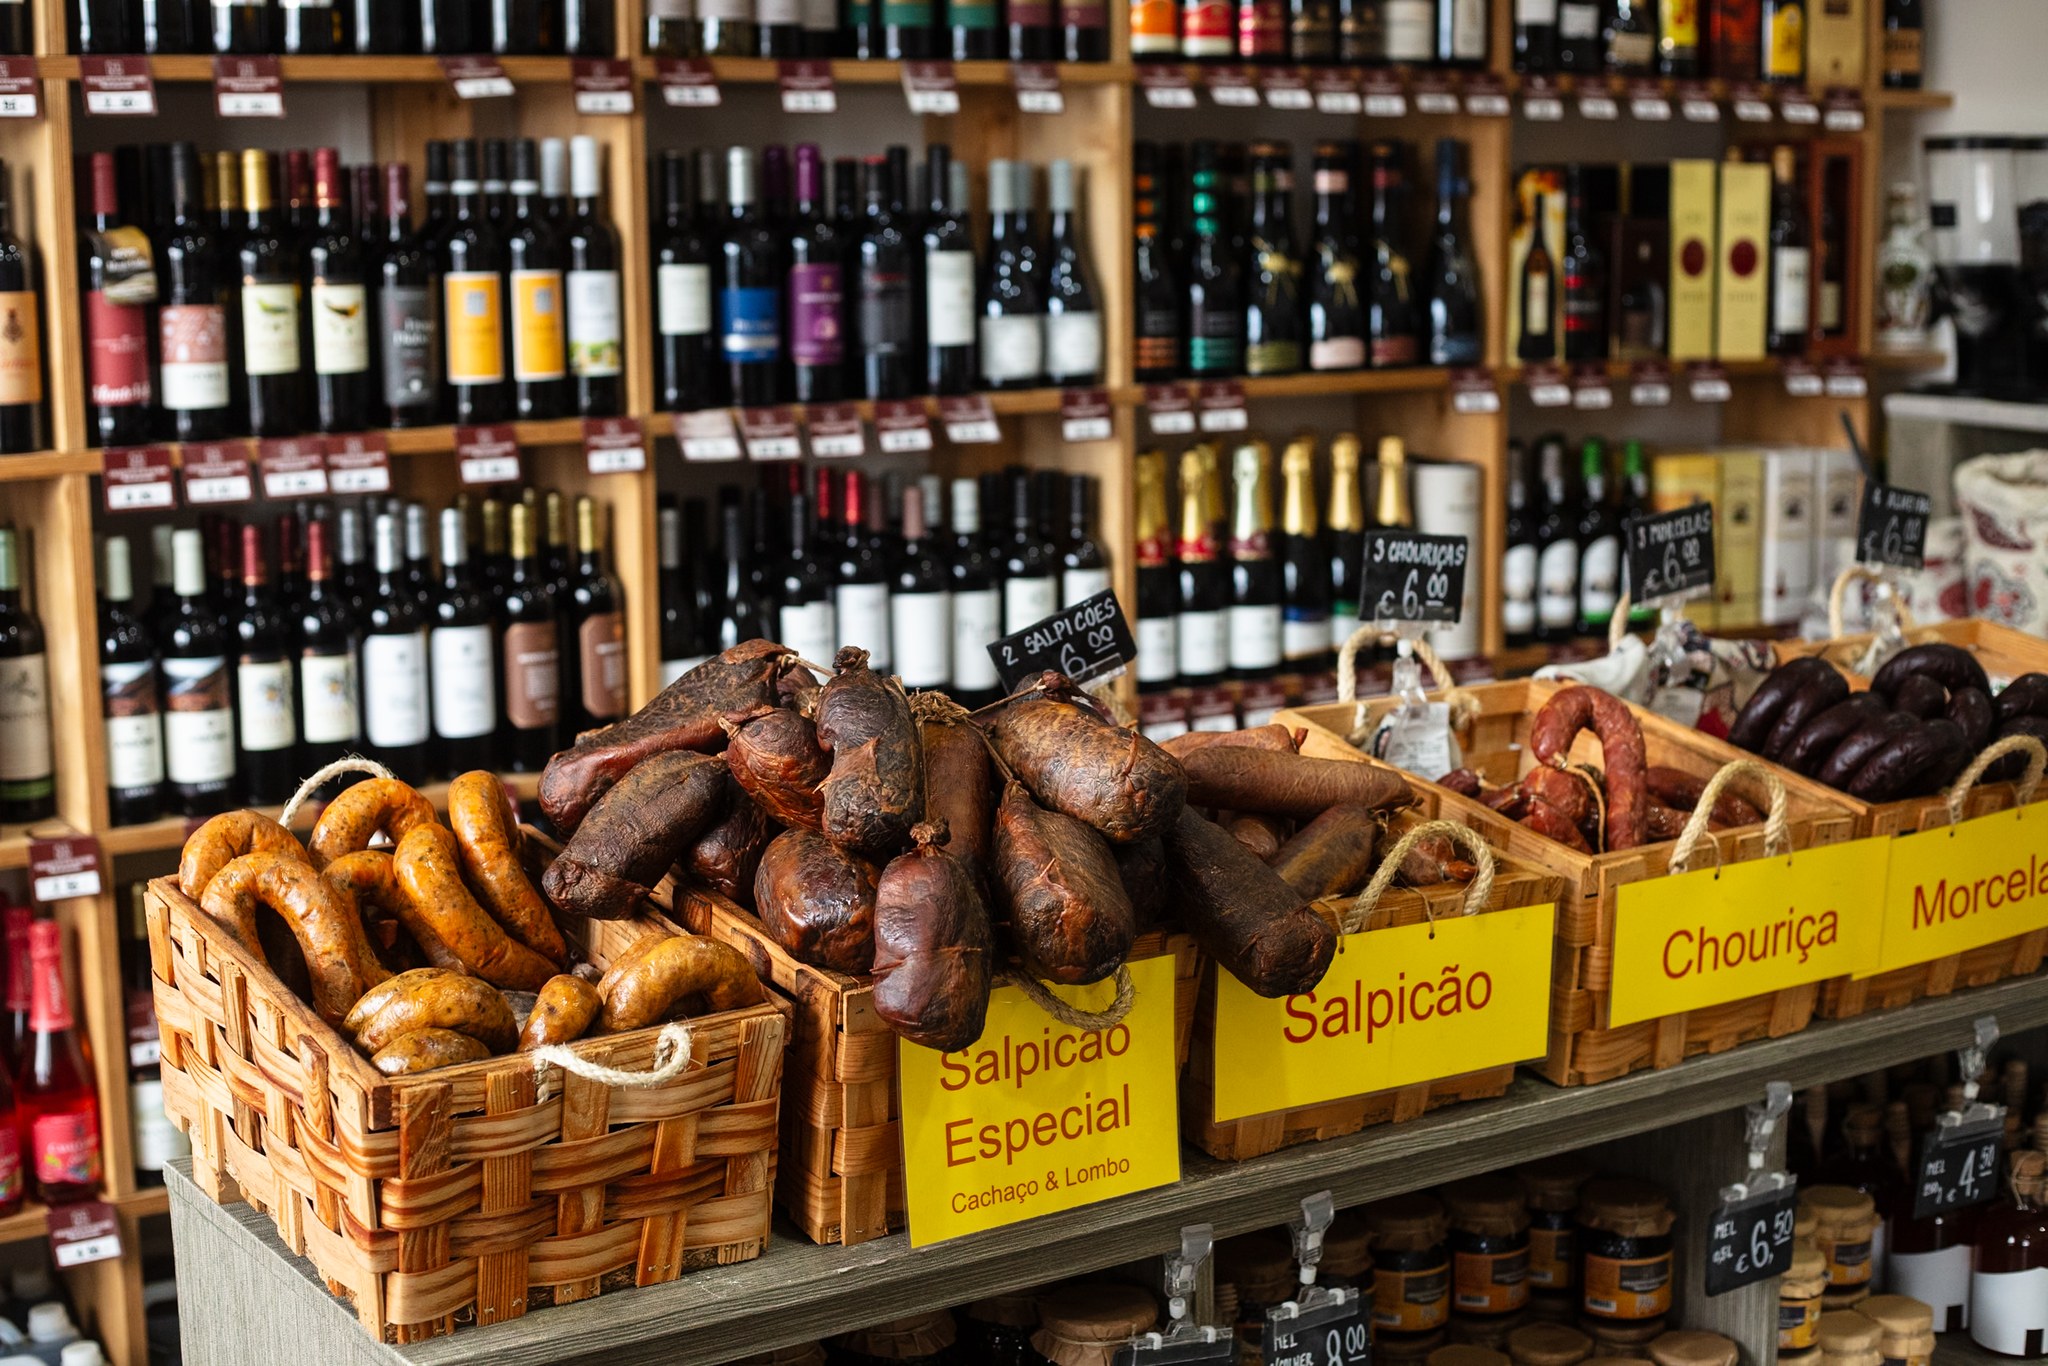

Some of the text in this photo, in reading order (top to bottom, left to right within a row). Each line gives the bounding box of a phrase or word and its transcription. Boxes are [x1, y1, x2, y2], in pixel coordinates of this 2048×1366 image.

[1373, 538, 1465, 573] 3 CHOURIÇAS
[1002, 645, 1019, 667] 2
[1662, 906, 1838, 980] Chouriça
[1283, 963, 1492, 1044] Salpicão
[945, 1083, 1131, 1168] Especial
[951, 1157, 1130, 1214] Cachaço & Lombo
